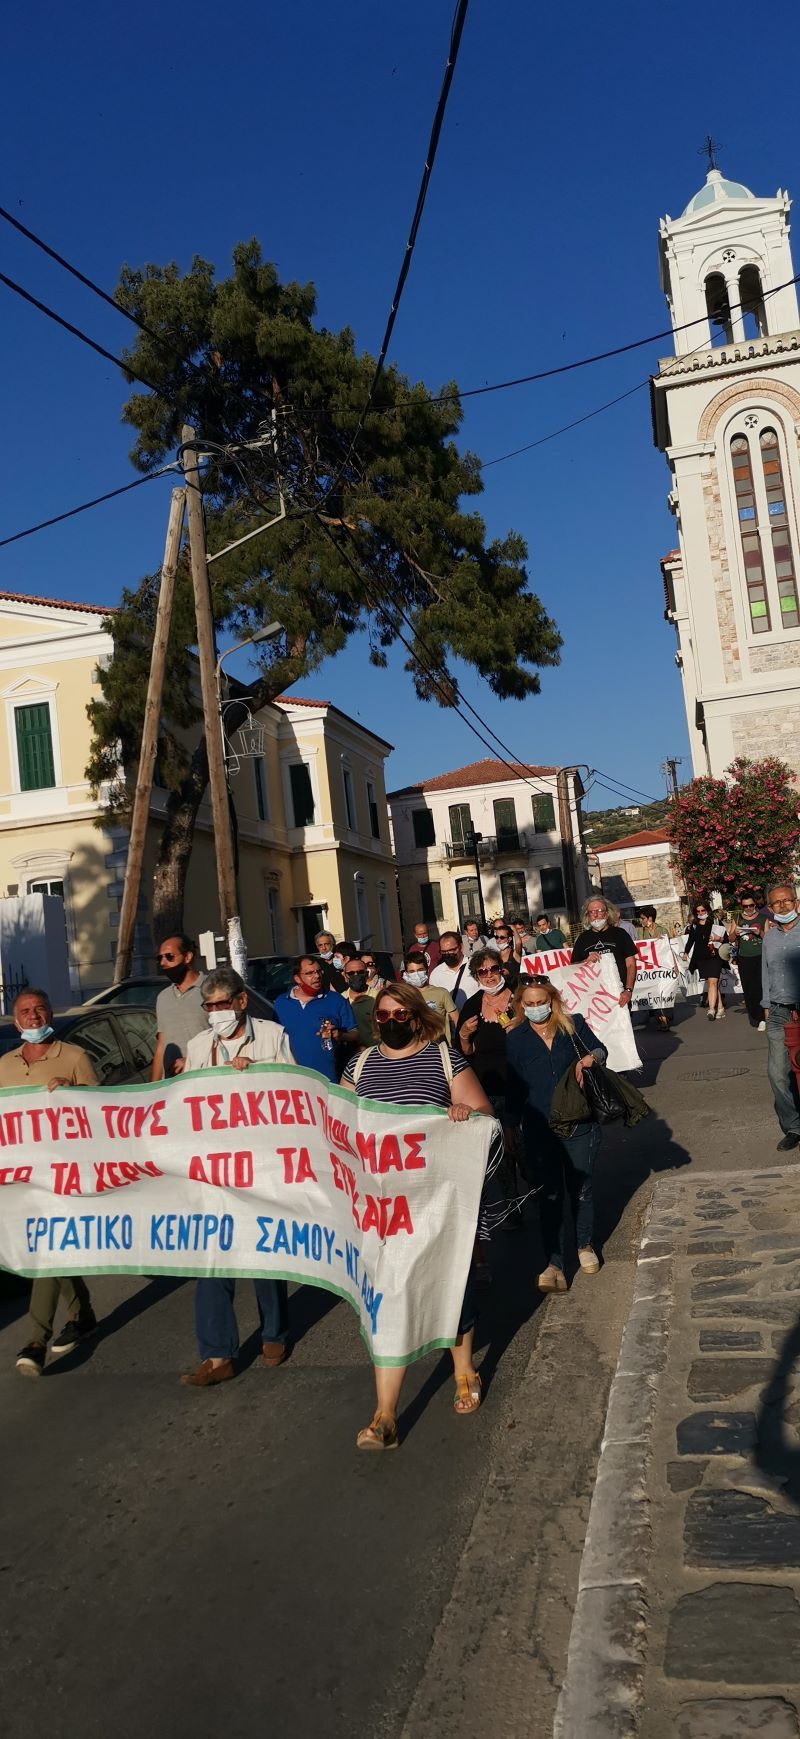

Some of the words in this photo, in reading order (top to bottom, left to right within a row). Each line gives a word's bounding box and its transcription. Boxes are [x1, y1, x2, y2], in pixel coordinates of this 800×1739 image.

[101, 1099, 168, 1138] ΤΟΥΣ
[184, 1089, 317, 1132] ΤΣΑΚΙΖΕΙ
[355, 1131, 426, 1174] ΜΑΣ
[50, 1162, 82, 1195] ΤΑ
[188, 1151, 254, 1188] ΑΠΟ
[277, 1147, 318, 1184] ΤΑ
[25, 1214, 134, 1253] ΕΡΓΑΤΙΚΟ
[150, 1213, 235, 1252] ΚΕΝΤΡΟ
